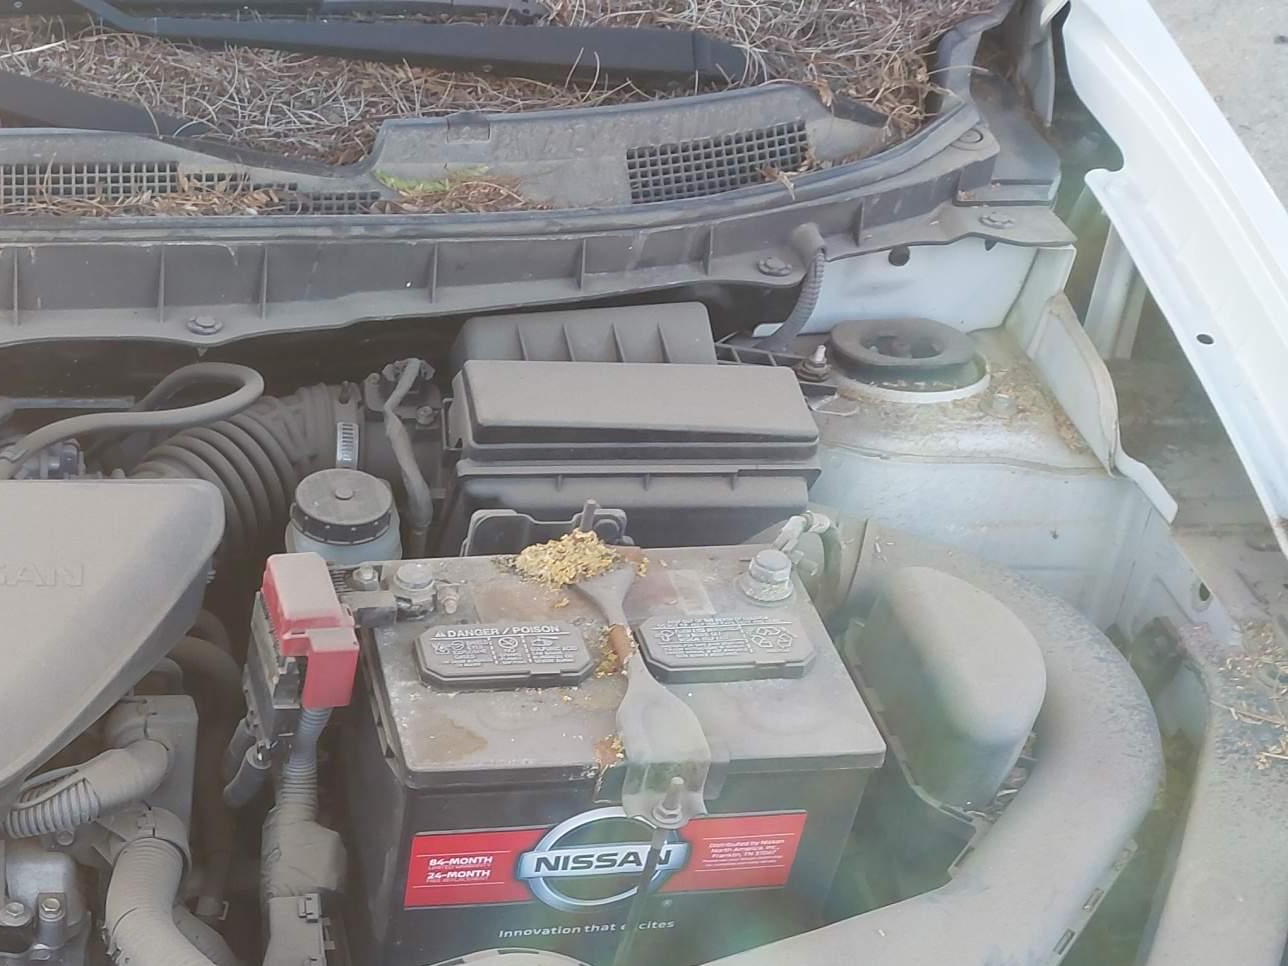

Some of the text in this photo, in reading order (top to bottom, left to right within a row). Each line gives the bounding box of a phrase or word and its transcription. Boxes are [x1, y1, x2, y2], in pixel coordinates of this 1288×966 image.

[447, 628, 500, 637] DANGER
[512, 625, 561, 634] POISON
[429, 856, 493, 866] 84-MONTH
[427, 869, 491, 880] 24-MONTH
[498, 925, 581, 938] Innovation
[583, 922, 616, 932] that
